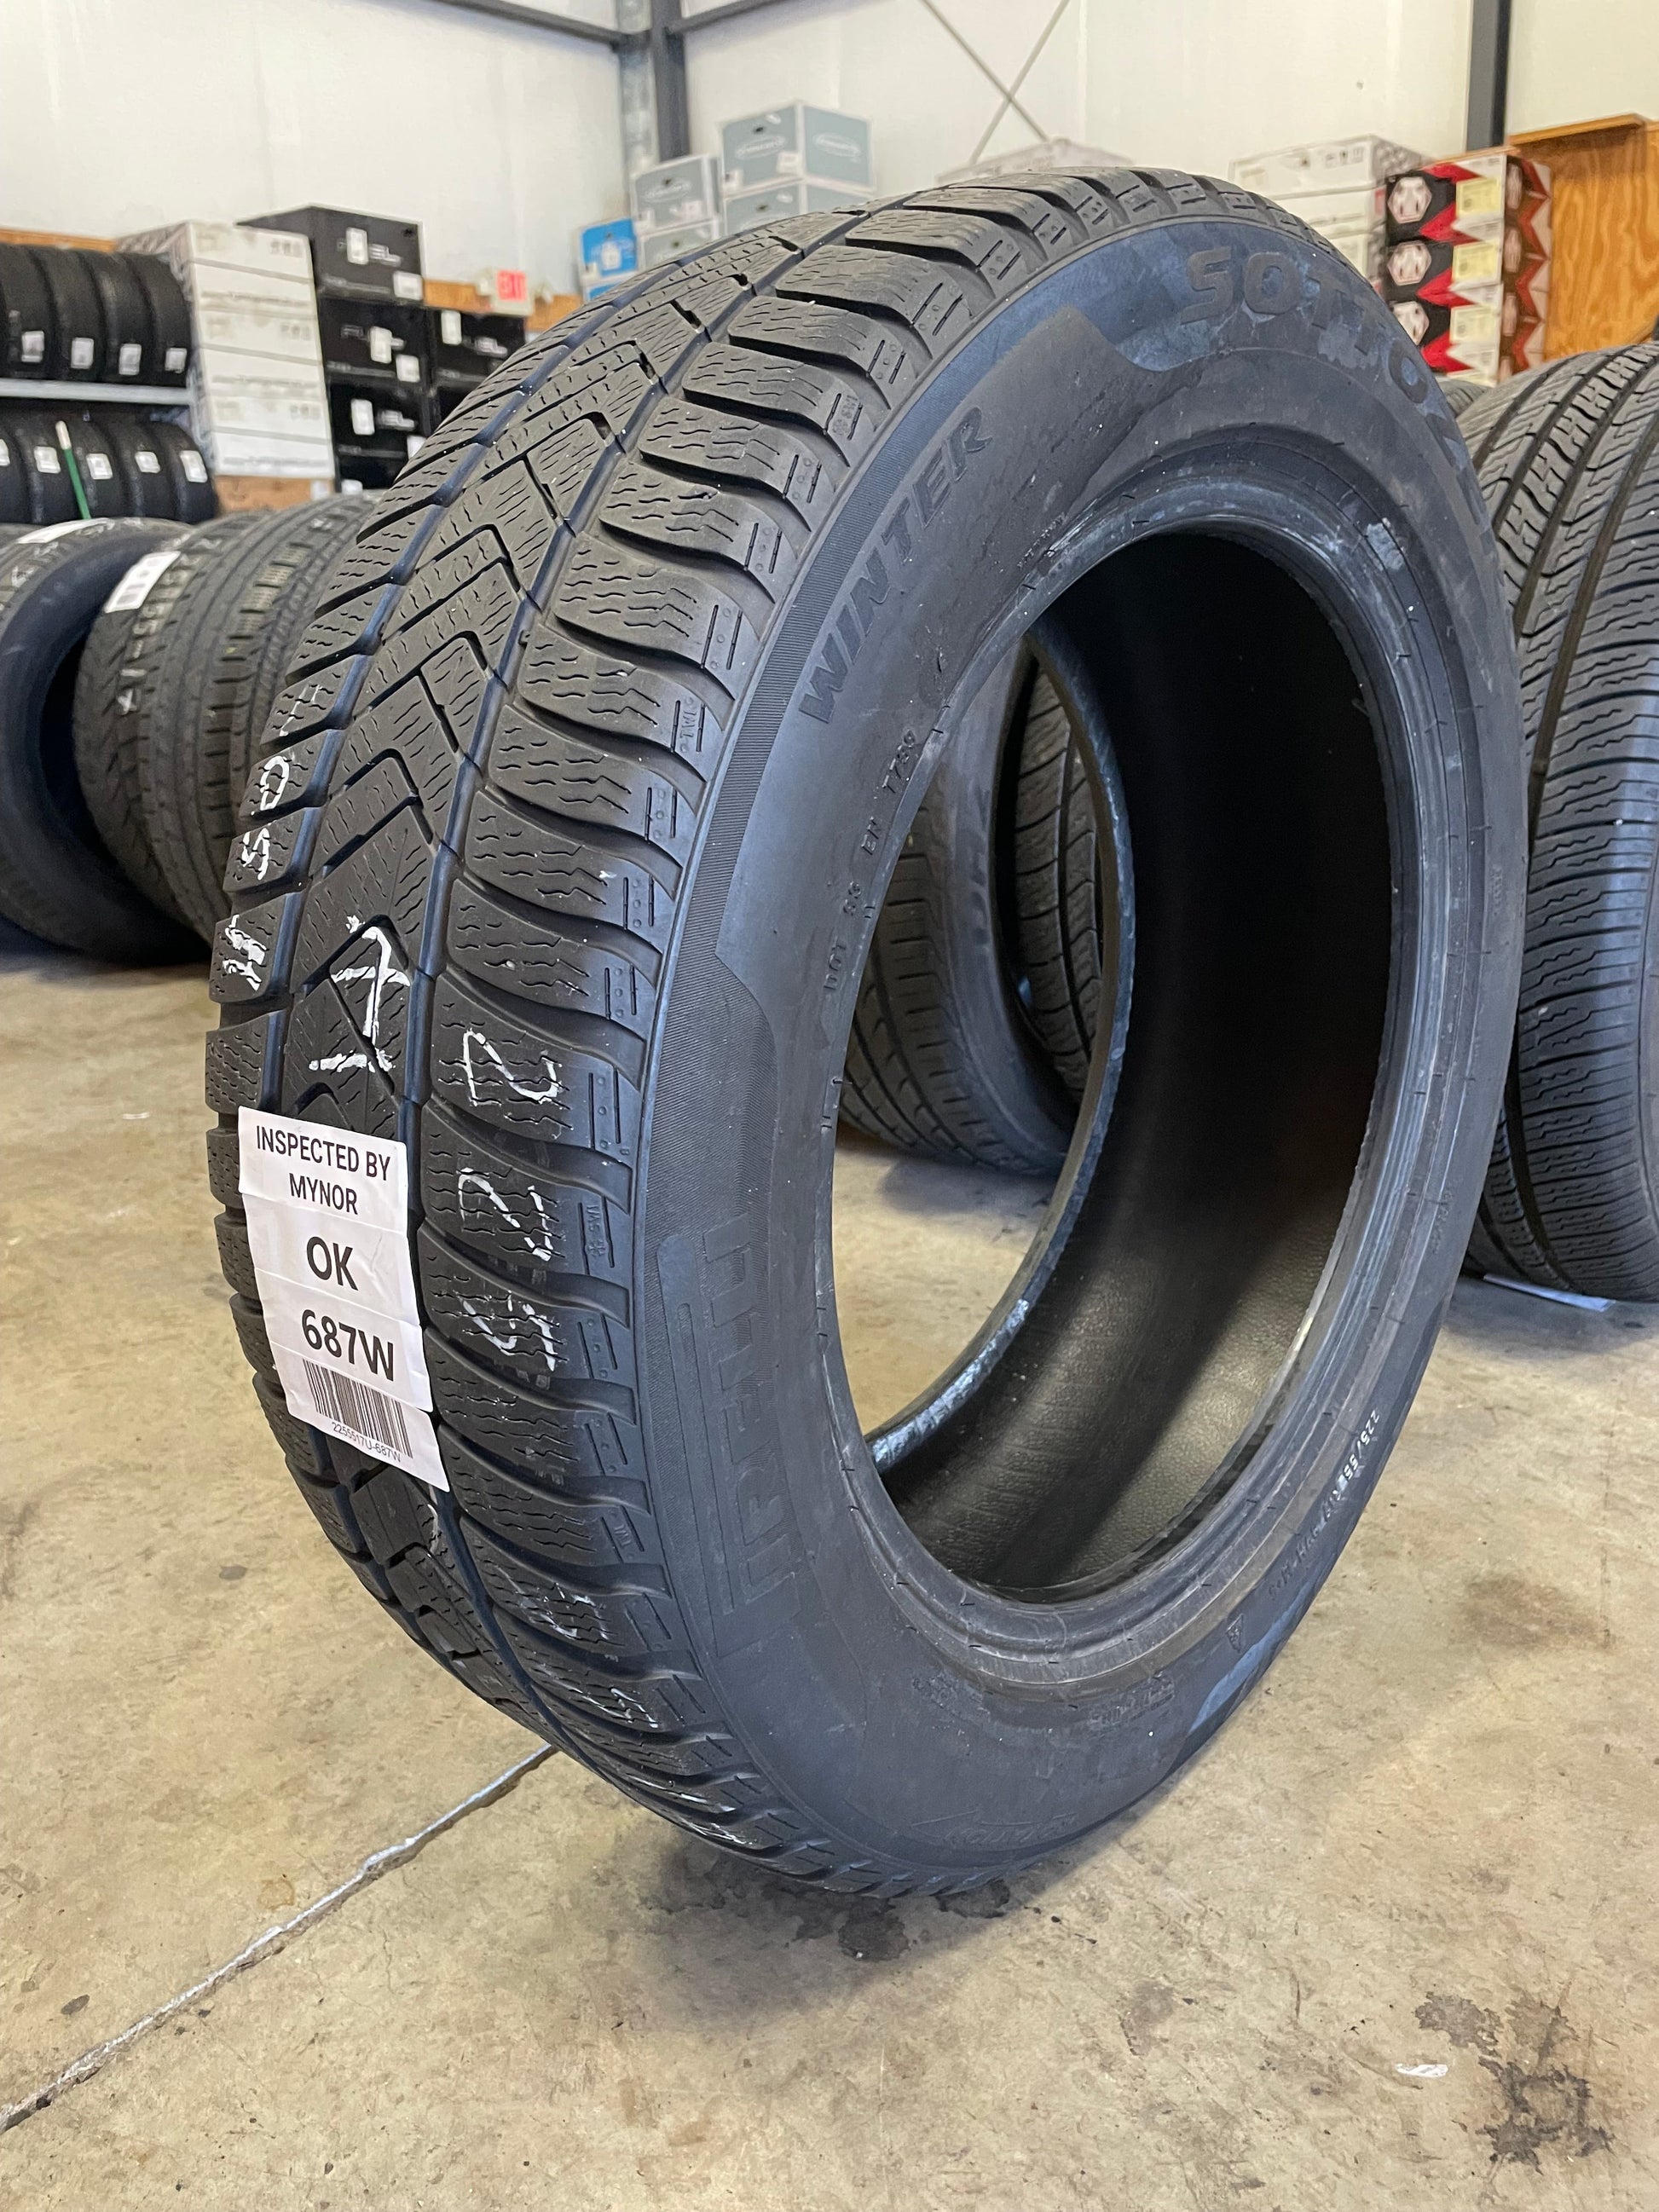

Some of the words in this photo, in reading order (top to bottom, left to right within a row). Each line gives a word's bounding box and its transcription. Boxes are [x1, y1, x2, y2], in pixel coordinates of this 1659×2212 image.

[799, 405, 993, 725] WINTER
[256, 1124, 360, 1173] INSPECTED
[366, 1151, 391, 1181] BY
[288, 1172, 359, 1216] MYNOR
[306, 1235, 359, 1291] OK
[302, 1308, 394, 1382] 687W
[331, 1421, 402, 1464] 2255517U-687W
